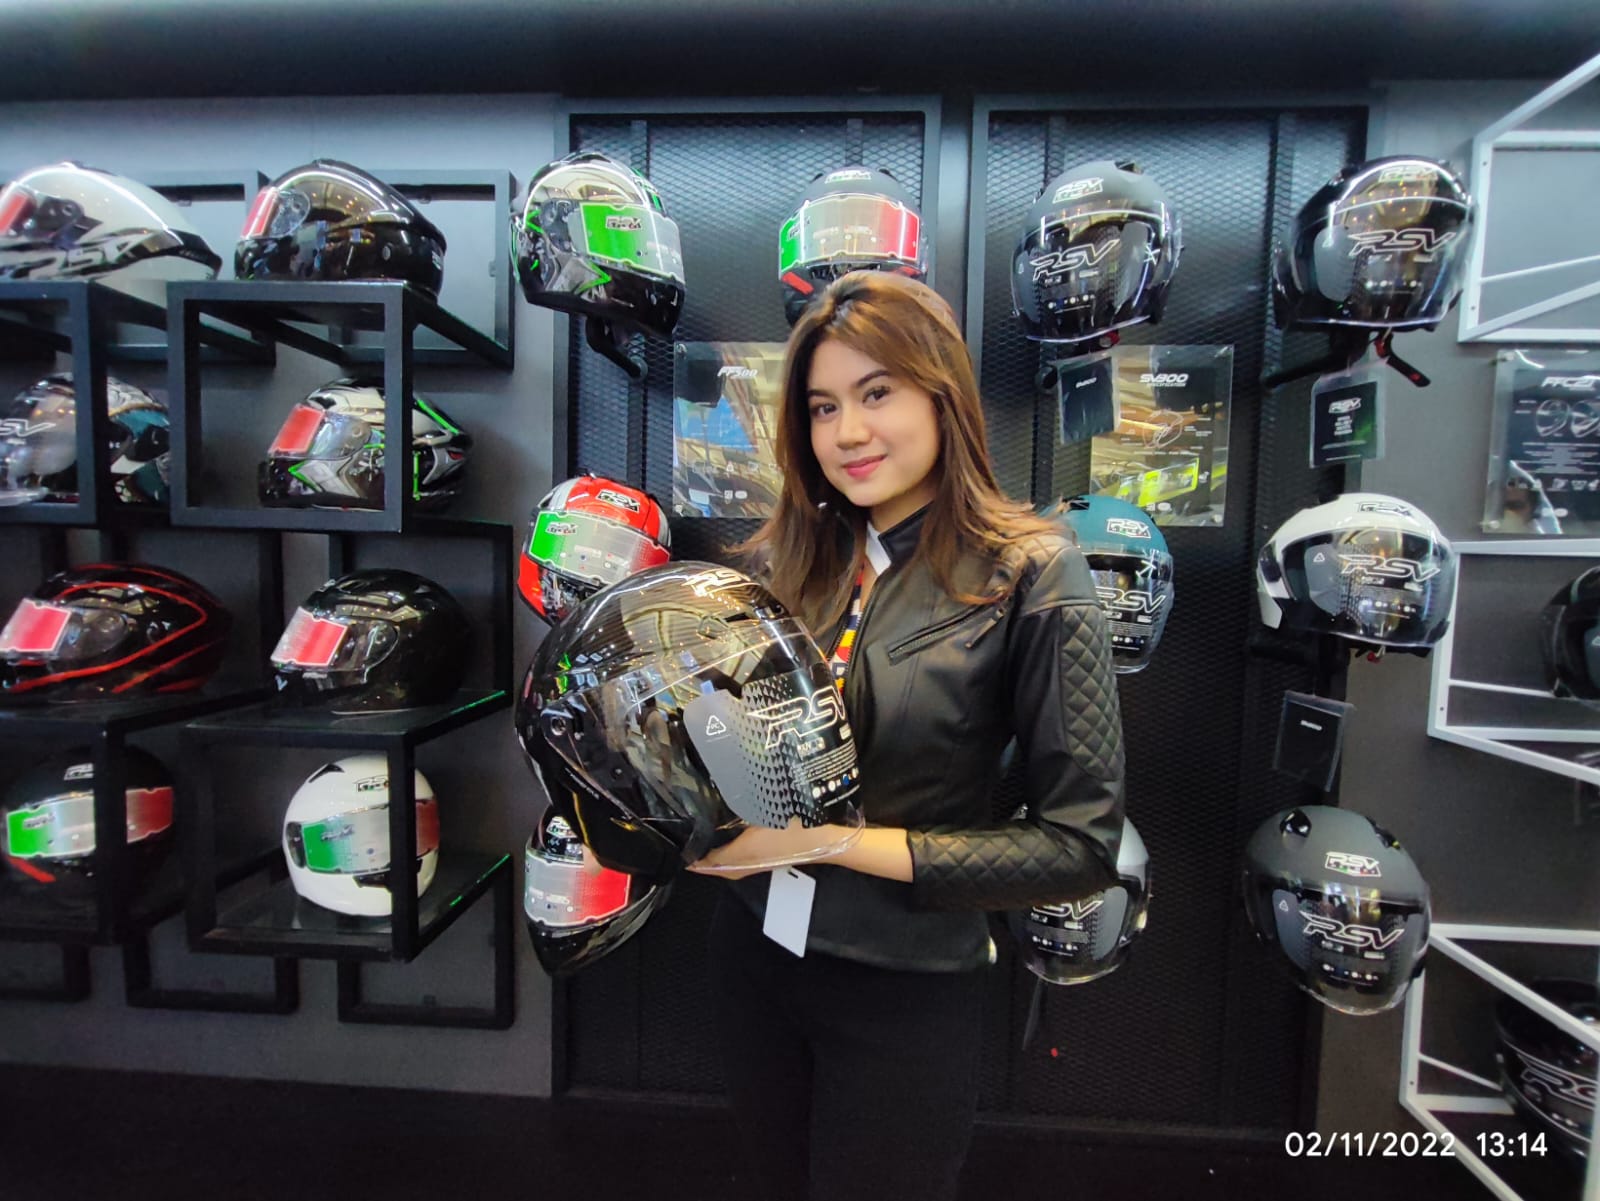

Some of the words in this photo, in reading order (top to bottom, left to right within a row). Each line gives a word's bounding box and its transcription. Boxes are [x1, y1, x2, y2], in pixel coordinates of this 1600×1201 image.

[1348, 227, 1457, 257] RSV
[1029, 238, 1121, 281] RSV
[0, 418, 57, 437] SV
[597, 489, 641, 513] RSV
[1106, 518, 1151, 538] RSV
[1338, 554, 1441, 582] RSV
[1095, 586, 1167, 613] RSV
[1323, 852, 1381, 877] RSV
[1299, 911, 1405, 950] RSV
